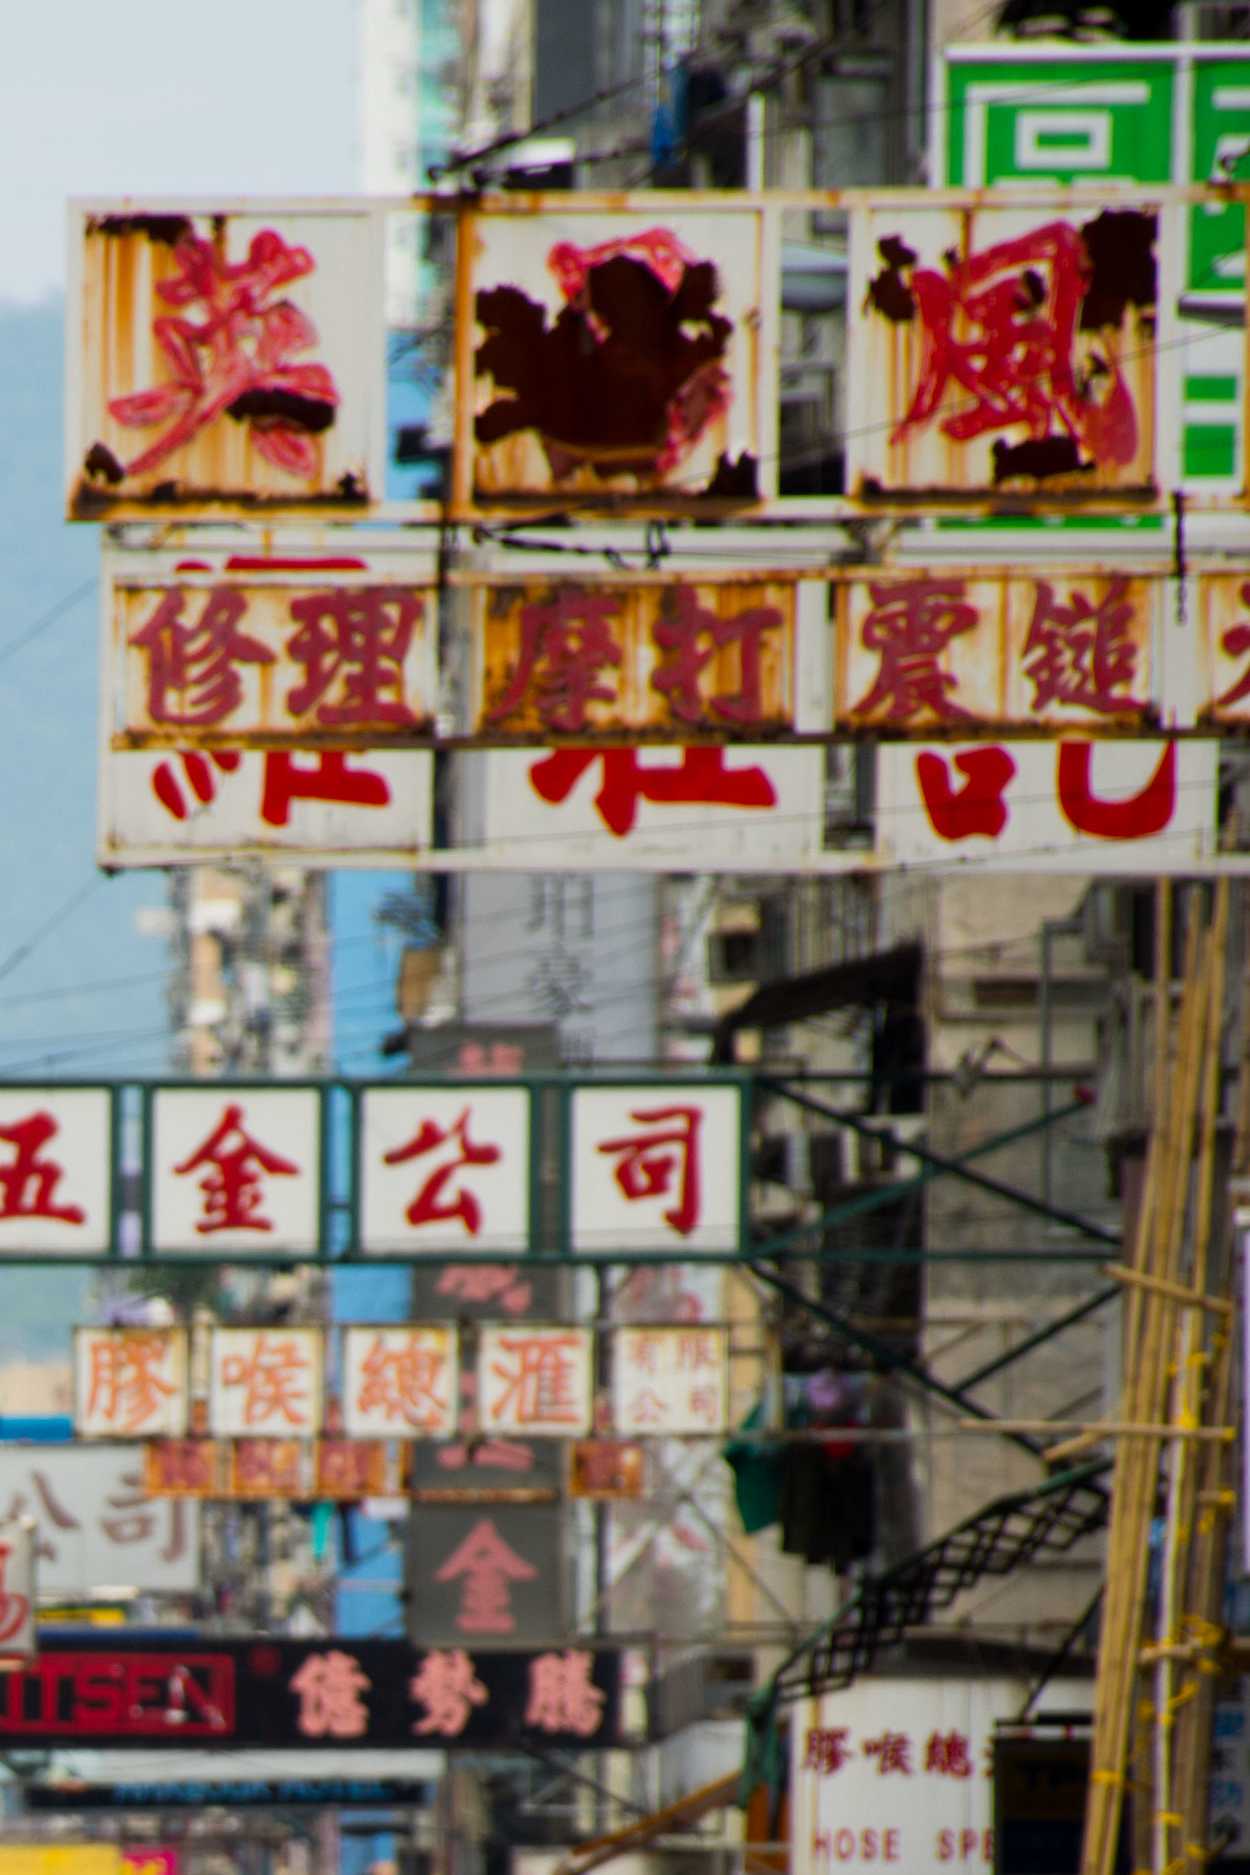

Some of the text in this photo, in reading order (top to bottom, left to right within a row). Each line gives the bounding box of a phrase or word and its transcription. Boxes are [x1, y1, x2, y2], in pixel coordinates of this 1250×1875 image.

[802, 1728, 993, 1778] 膠喉總
[811, 1828, 900, 1863] HOSE
